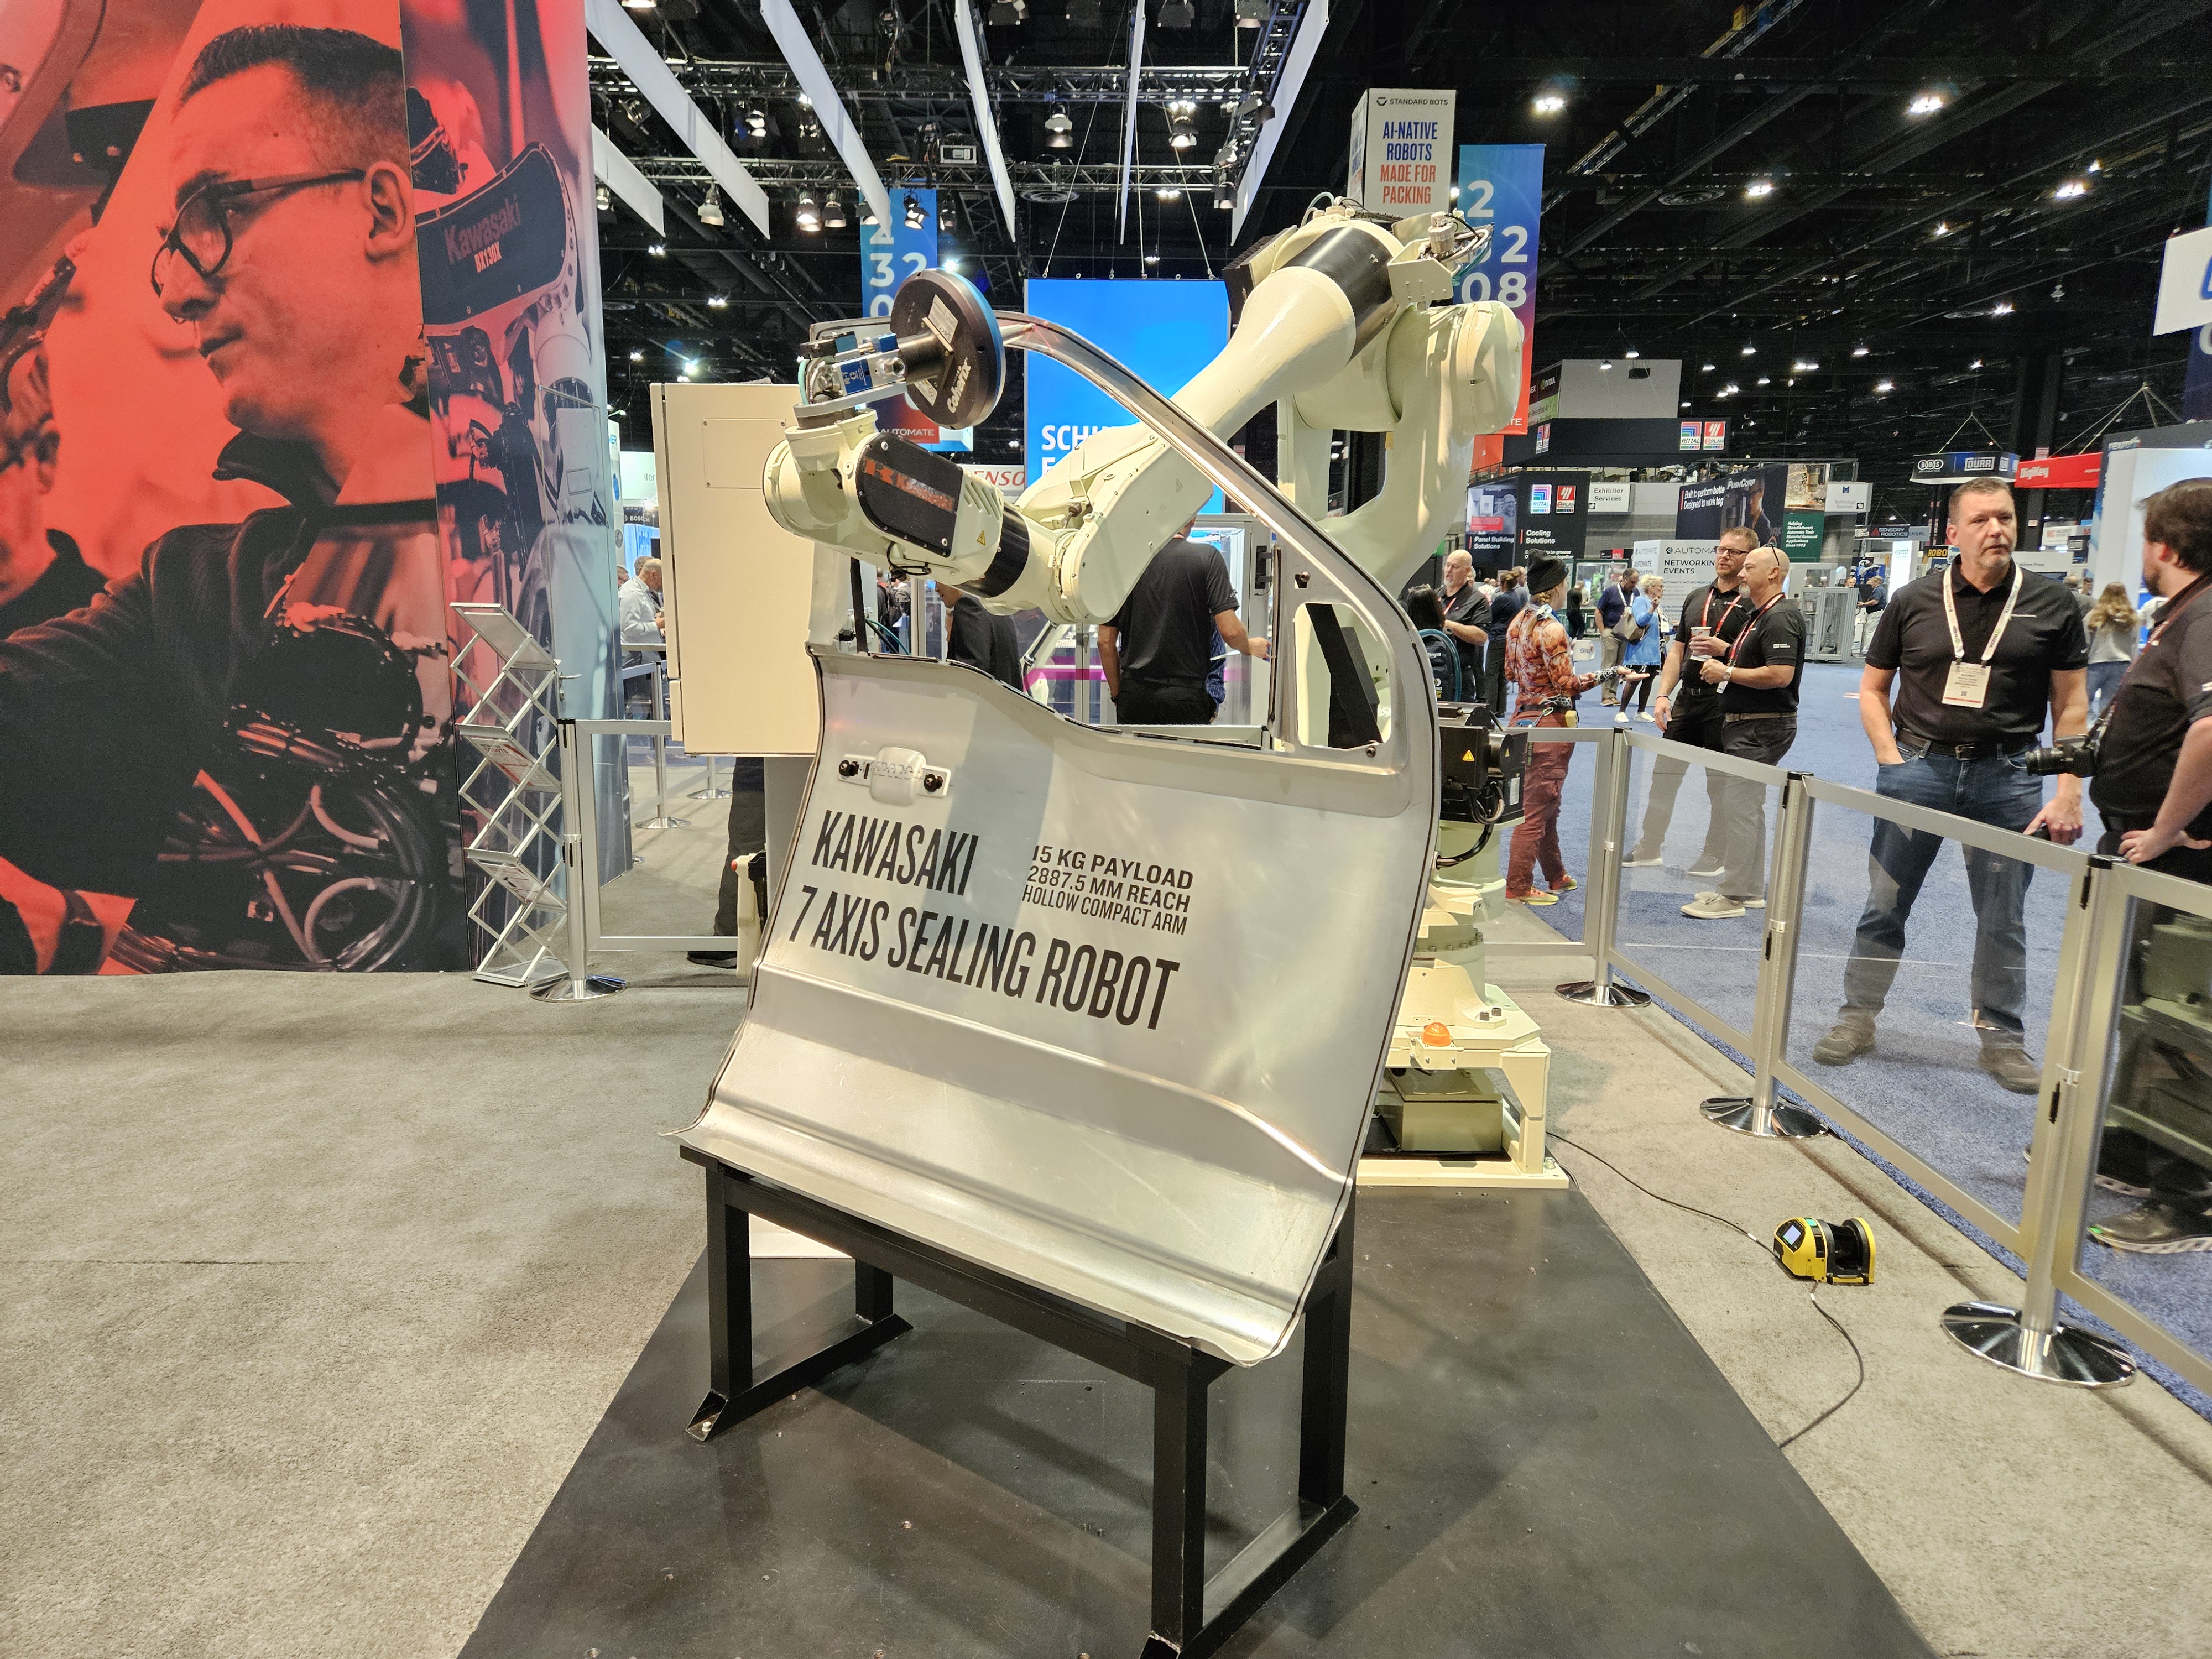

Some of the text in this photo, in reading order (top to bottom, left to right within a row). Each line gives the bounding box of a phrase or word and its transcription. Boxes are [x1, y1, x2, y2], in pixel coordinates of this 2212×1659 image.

[1383, 121, 1438, 139] AI-NATIVE
[1386, 143, 1432, 161] ROBOTS
[1380, 164, 1436, 182] MADE FOR
[1383, 186, 1431, 204] PACKING
[444, 193, 521, 264] Kawasaki
[474, 241, 502, 273] BX130X
[947, 357, 971, 414] Coherix
[1967, 457, 1992, 469] DÜRR
[974, 471, 1025, 487] ENSO
[2020, 466, 2049, 480] DigiKey
[1684, 485, 1725, 499] Built to perform bette
[1684, 499, 1702, 510] Designed
[1706, 498, 1715, 506] work
[1928, 549, 1948, 557] ROBO
[2004, 590, 2017, 614] AUTOMATE
[1989, 633, 1999, 648] NVIDIA
[811, 810, 979, 896] KAWASAKI
[1032, 845, 1193, 889] 15 KG PAYLOAD
[1027, 865, 1191, 913] 2887.5 MM REACH
[1022, 885, 1188, 936] HOLLOW COMPACT ARM
[789, 885, 1180, 1030] 7 AXIS SEALING ROBOT
